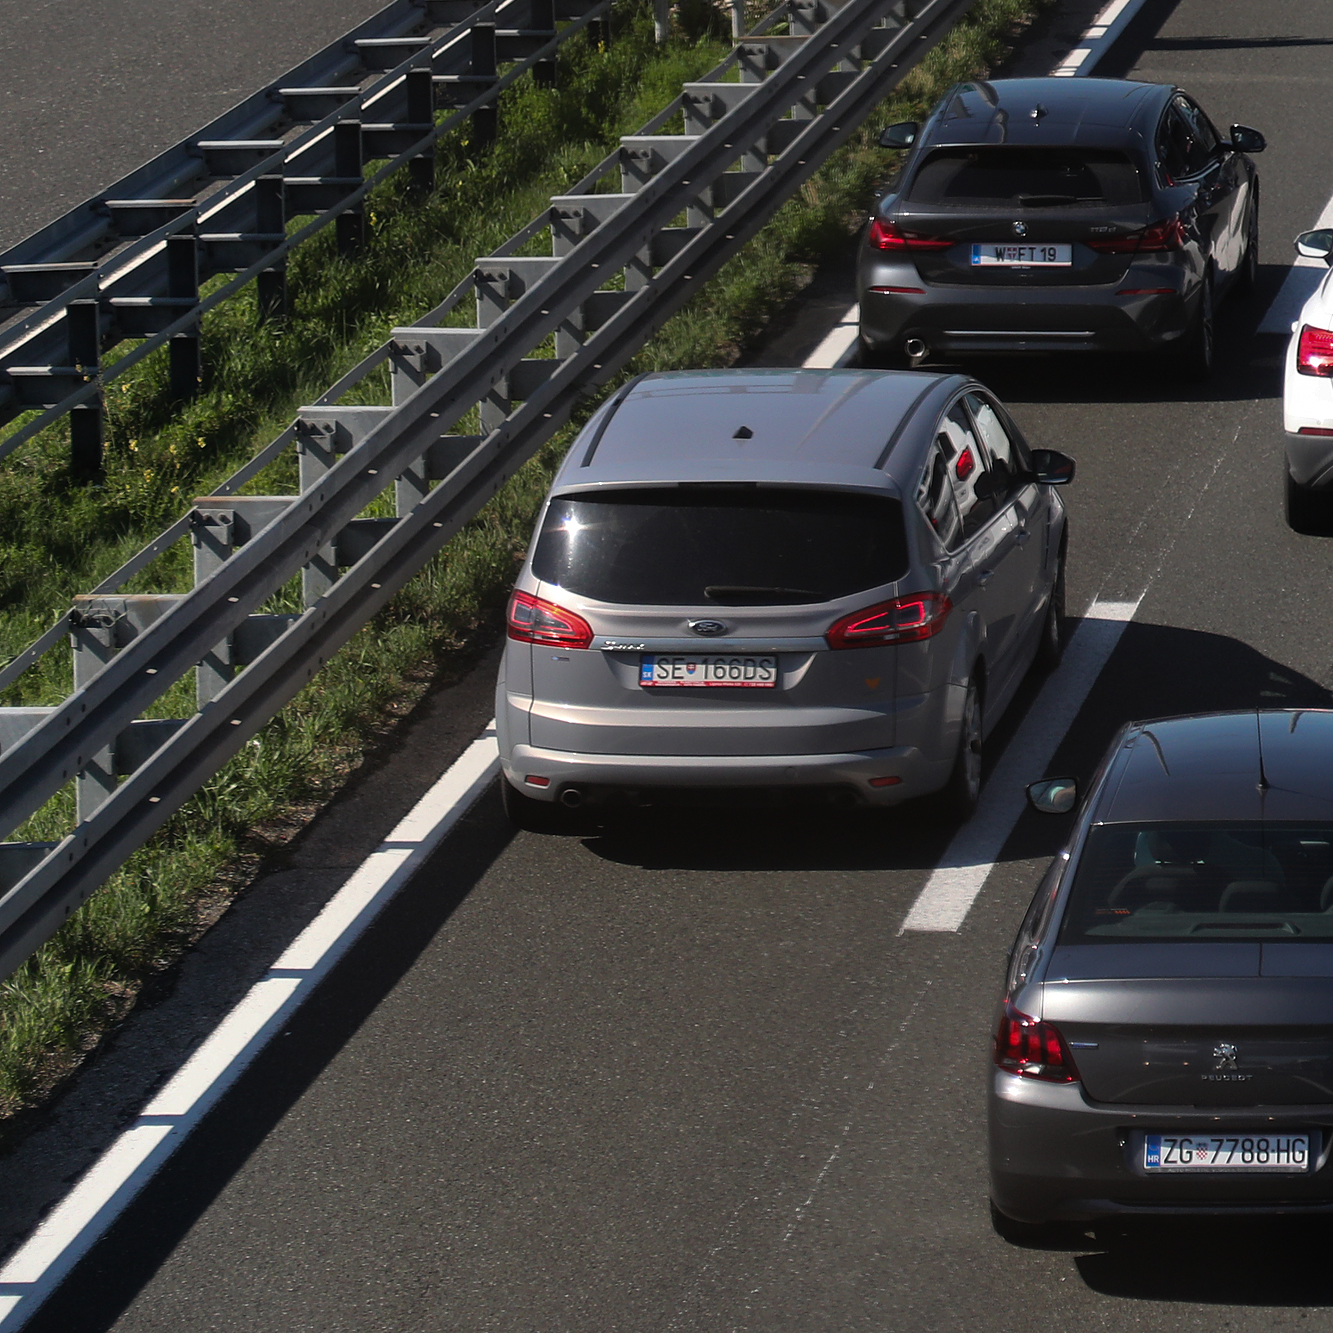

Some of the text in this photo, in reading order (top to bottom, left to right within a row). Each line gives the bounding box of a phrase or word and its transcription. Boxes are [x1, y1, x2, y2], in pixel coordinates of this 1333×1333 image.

[995, 247, 1006, 262] W
[1018, 246, 1036, 262] FT
[1041, 247, 1057, 262] 19
[656, 657, 685, 680] SE
[702, 658, 773, 680] 166DS
[1147, 1155, 1160, 1163] HR
[1163, 1138, 1193, 1164] ZG
